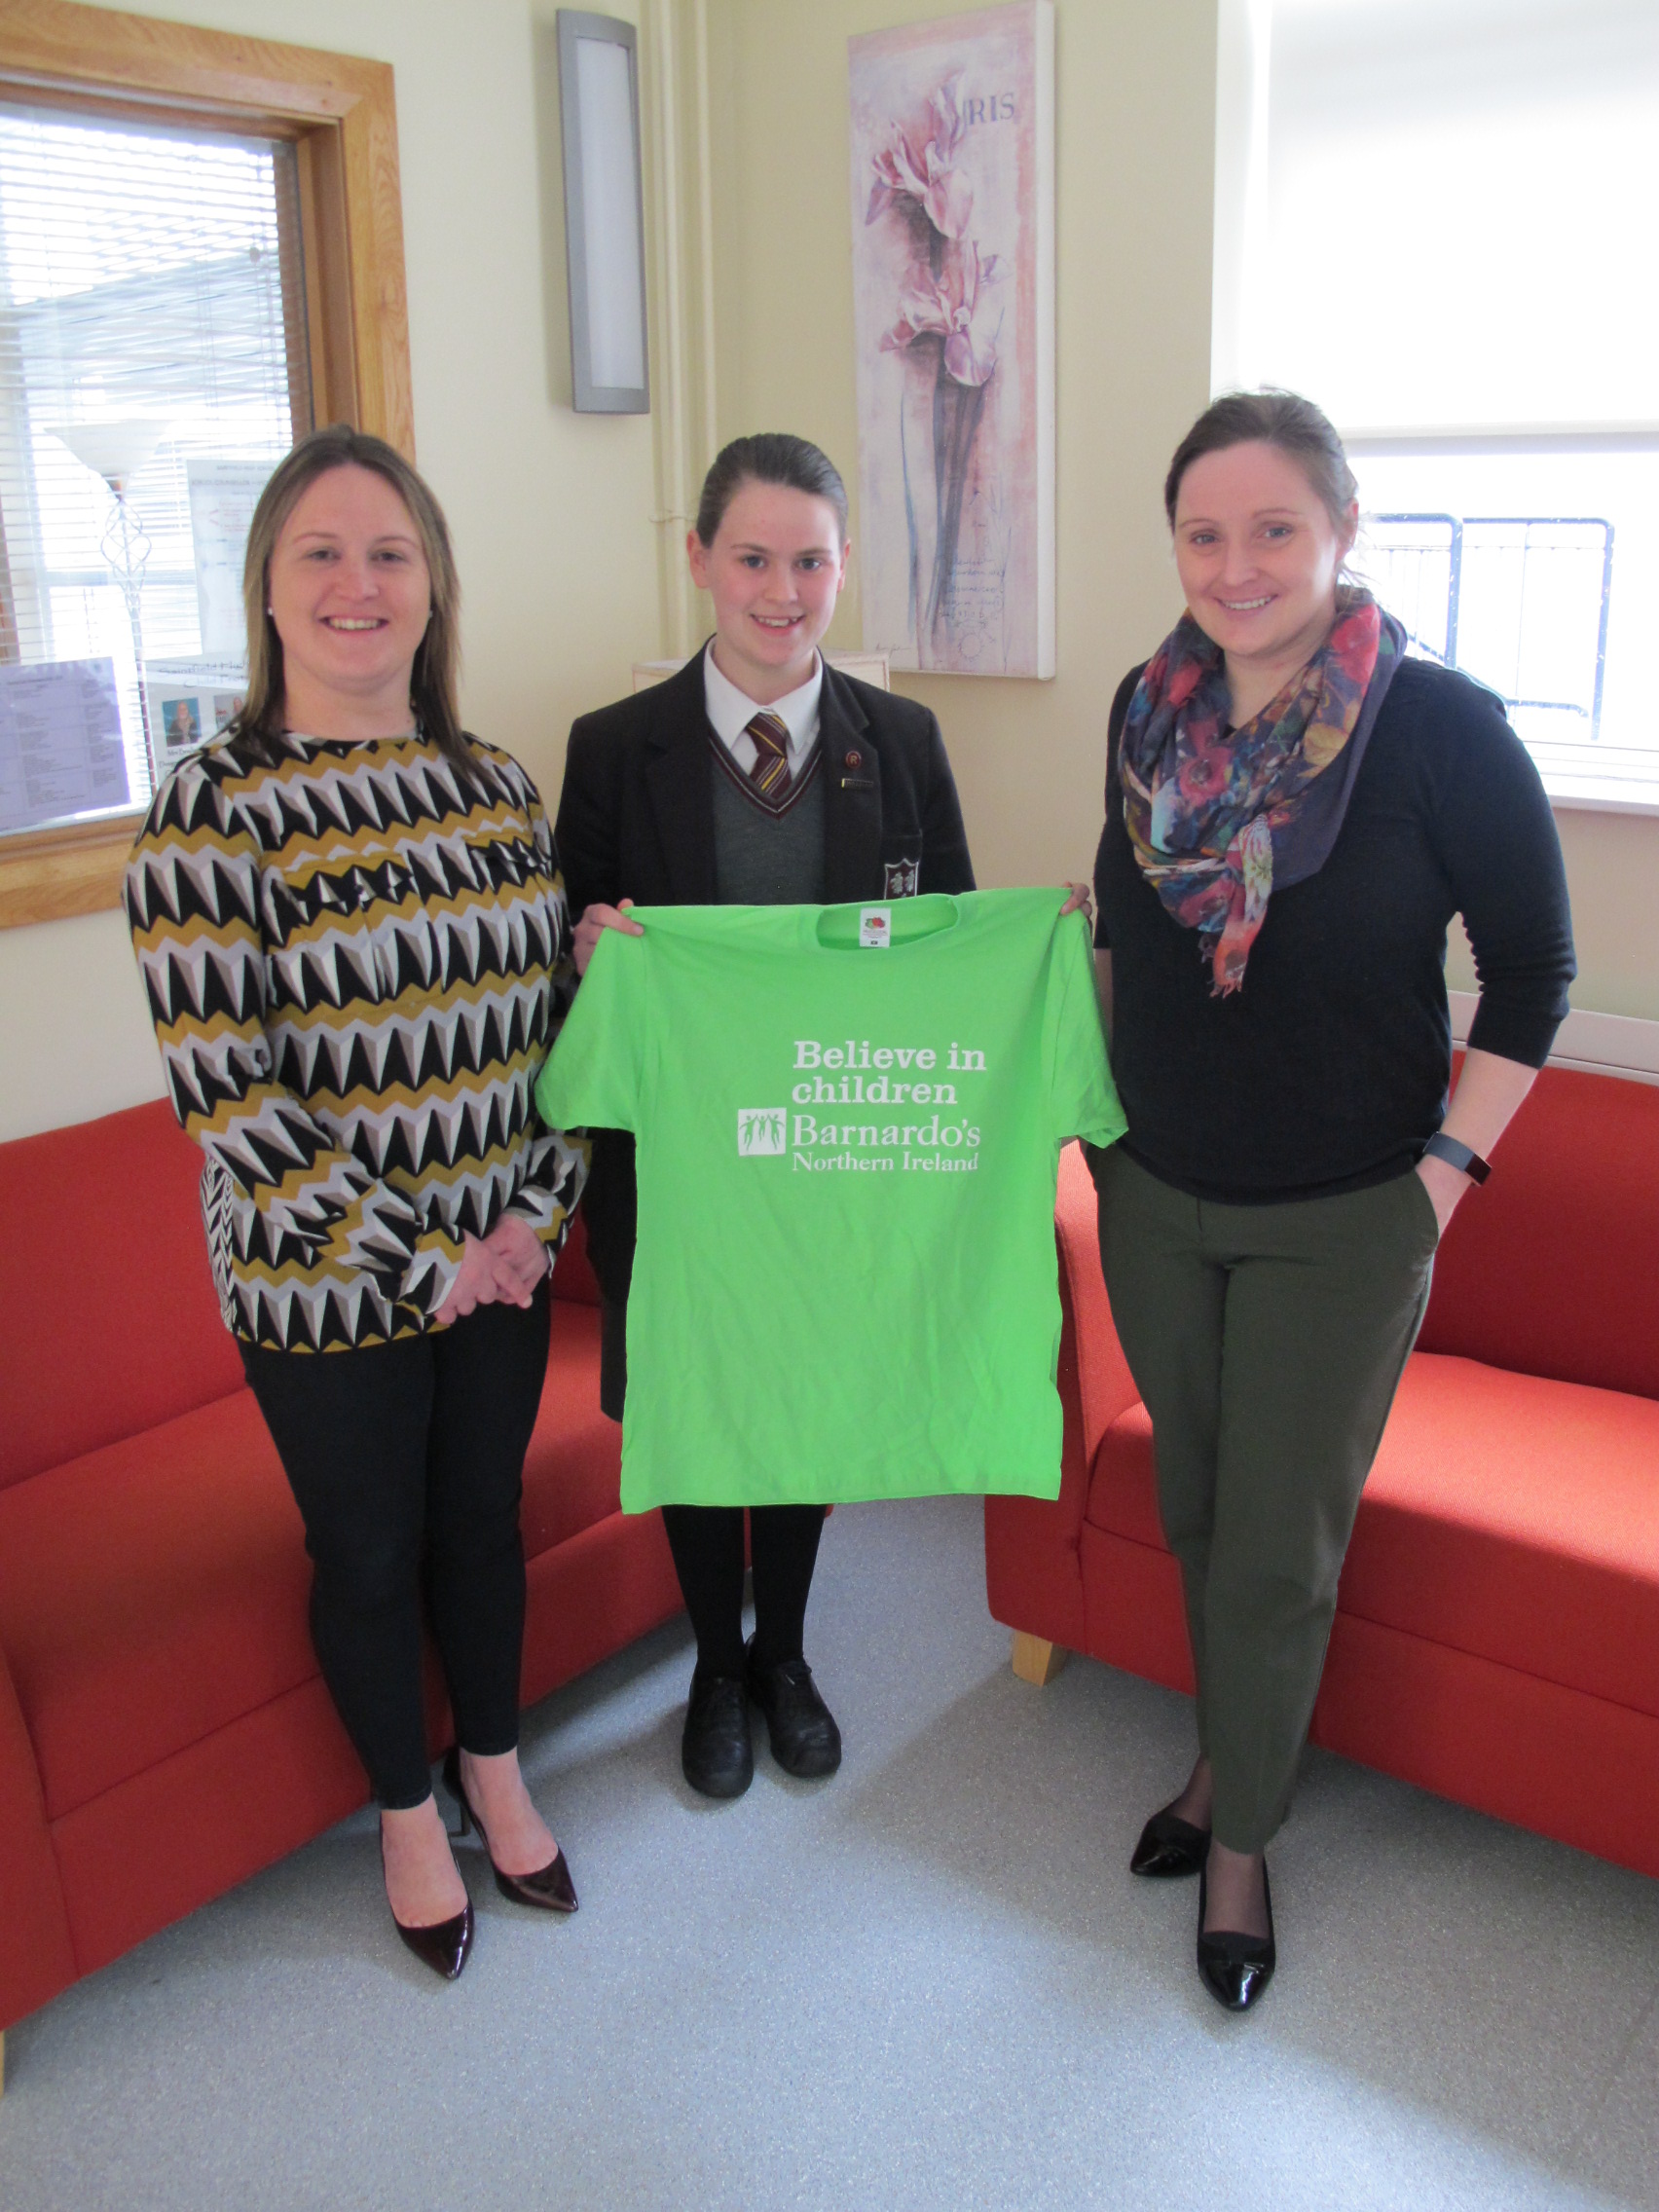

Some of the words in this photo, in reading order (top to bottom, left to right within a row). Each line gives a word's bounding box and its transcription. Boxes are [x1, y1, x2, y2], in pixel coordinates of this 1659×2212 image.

[793, 1040, 937, 1070] Believe
[946, 1042, 986, 1071] in
[792, 1076, 958, 1104] children
[792, 1114, 981, 1147] Barnardo's
[793, 1151, 894, 1171] Northern
[903, 1151, 979, 1171] Ireland
